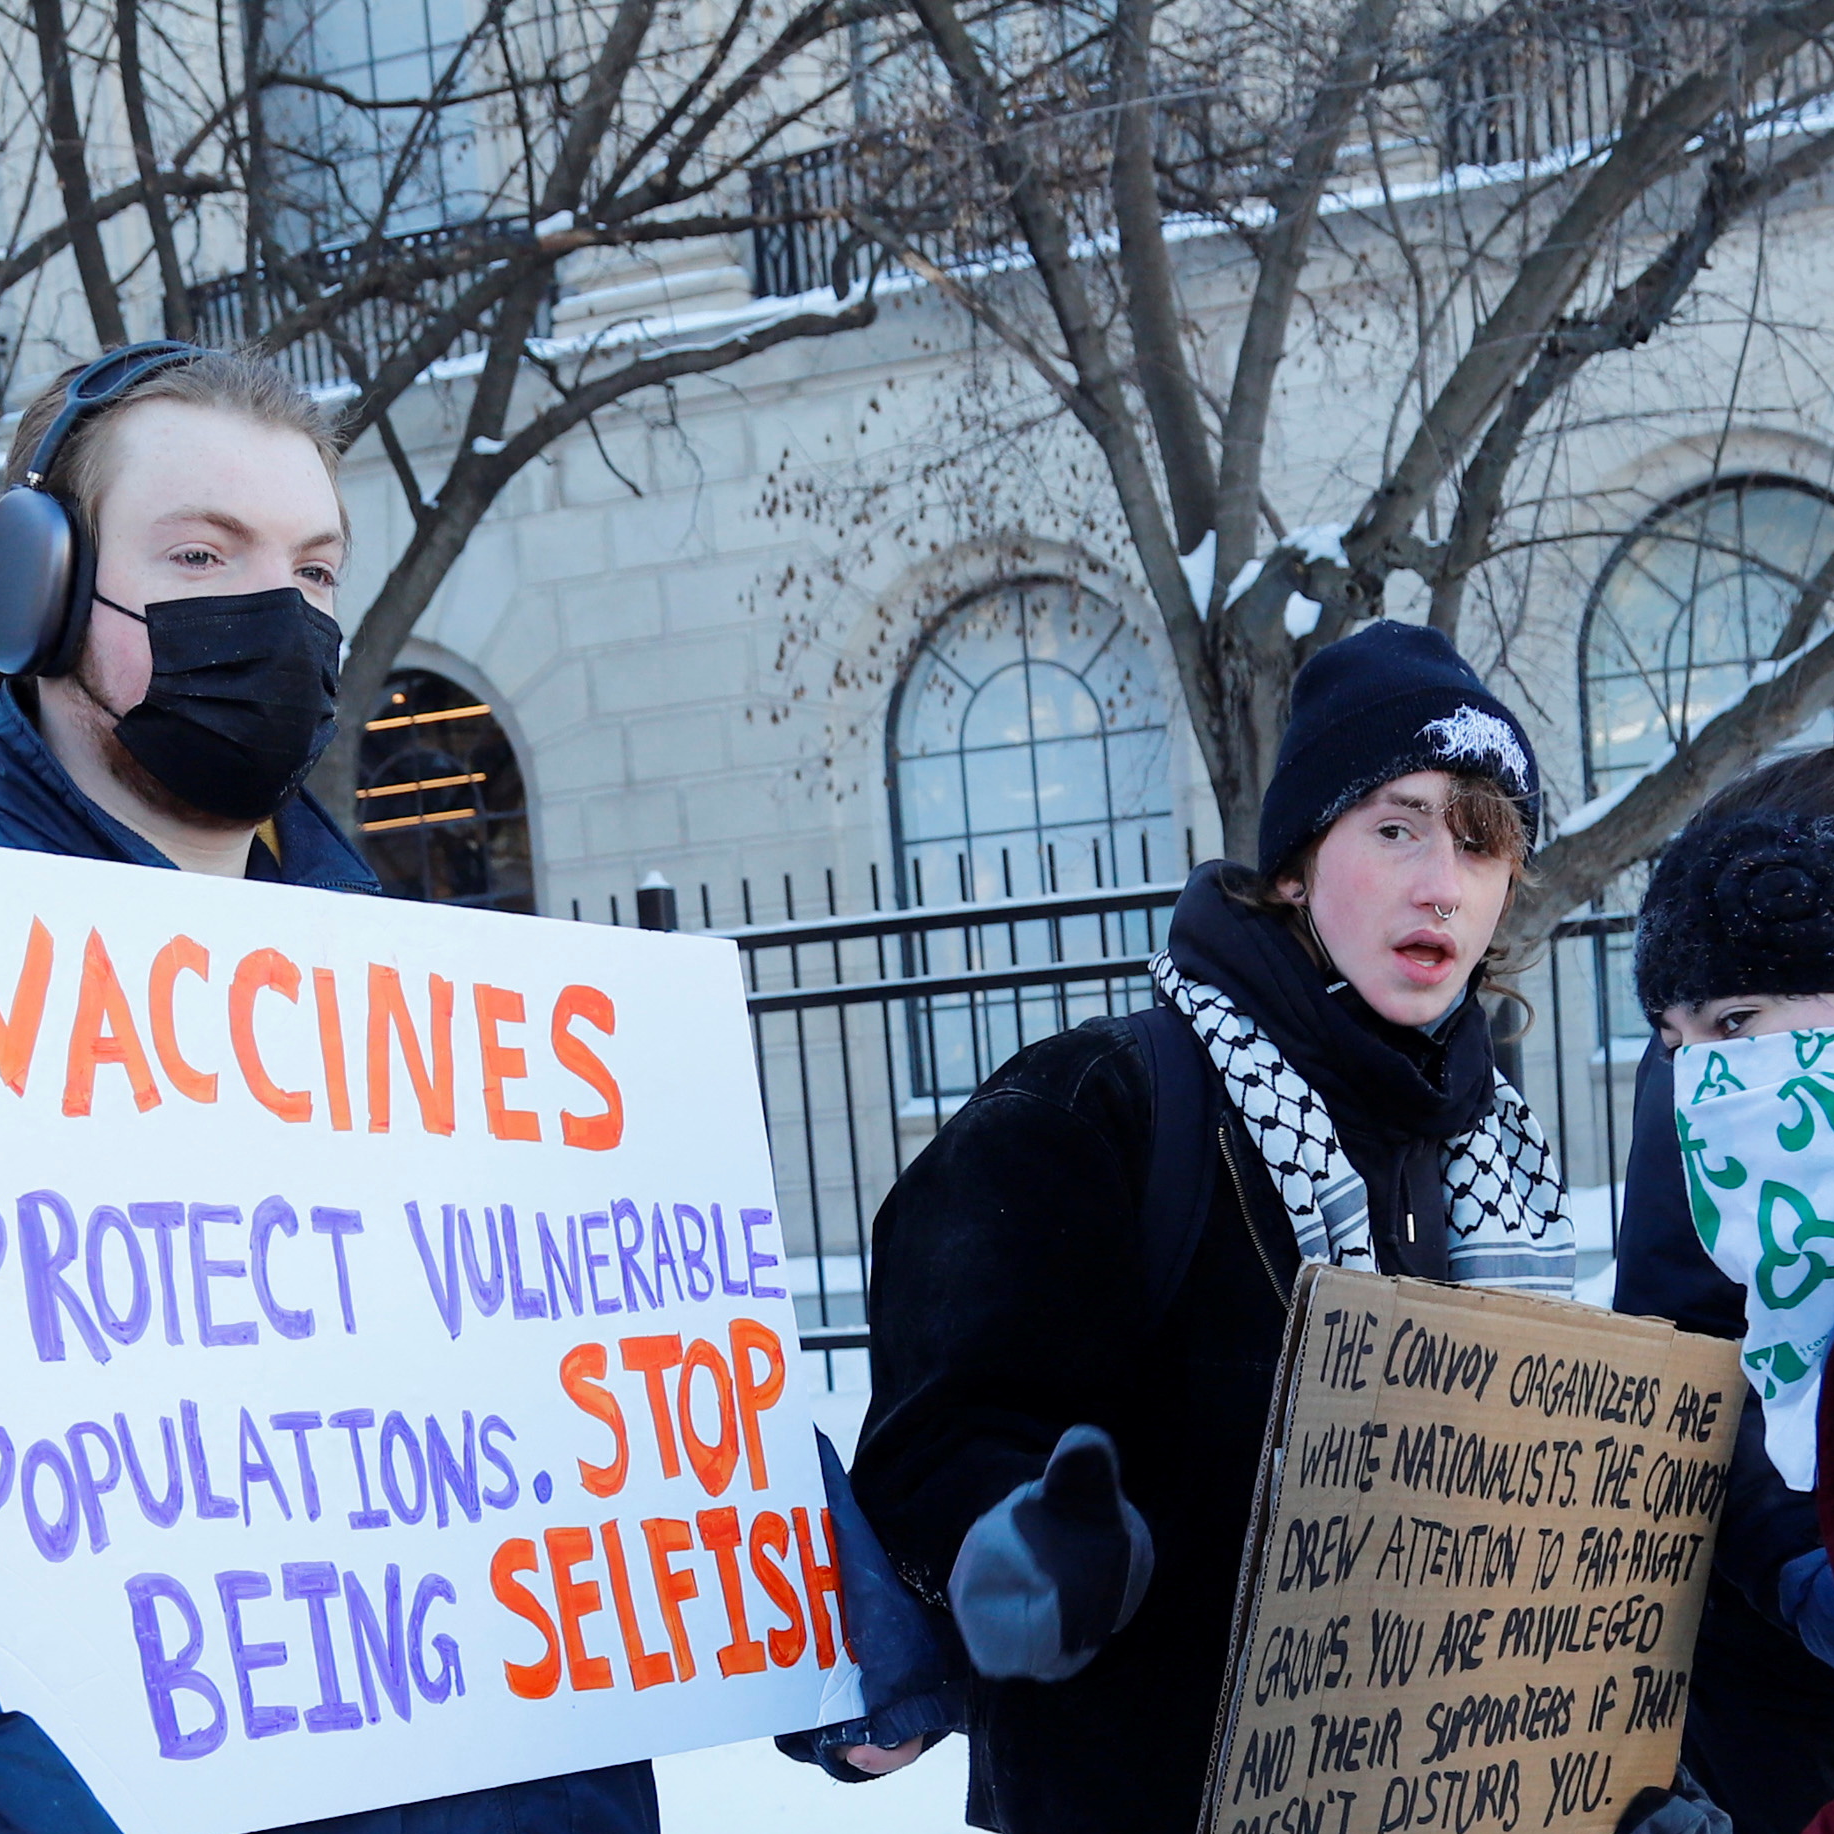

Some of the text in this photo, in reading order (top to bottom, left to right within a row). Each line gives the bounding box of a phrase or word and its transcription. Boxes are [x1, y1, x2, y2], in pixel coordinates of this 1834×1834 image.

[404, 1197, 786, 1341] VULNERABLE
[559, 1318, 787, 1499] STOP
[1320, 1309, 1721, 1442] THE CONVOY ORGANIZERS ARE
[1299, 1421, 1730, 1524] WHITE NATIONALISTS. THE CONVOY
[1277, 1515, 1704, 1594] DREW ATTENTION TO FAR-RIGHT
[124, 1504, 857, 1761] BEING SELFISH
[1255, 1595, 1664, 1705] GROUPS. YOU ARE PRIVILEGED
[1232, 1665, 1686, 1804] AND THEIR SUPPORTERS IF THAT
[1544, 1751, 1612, 1827] YOU.
